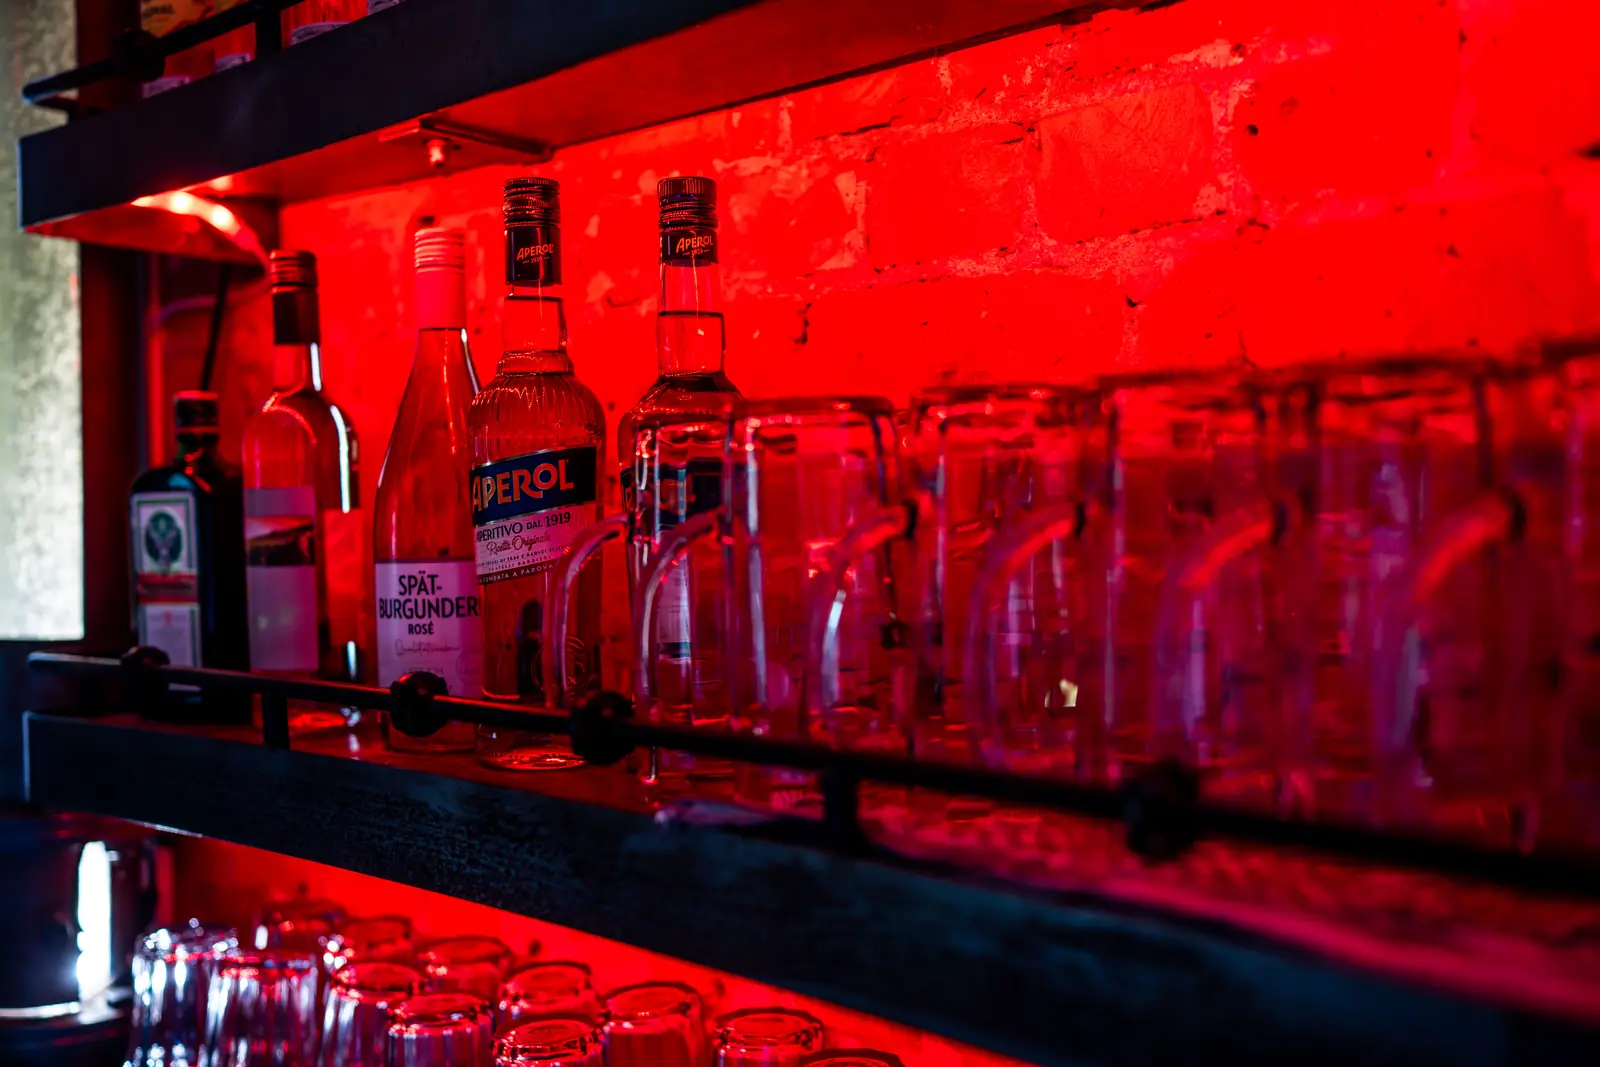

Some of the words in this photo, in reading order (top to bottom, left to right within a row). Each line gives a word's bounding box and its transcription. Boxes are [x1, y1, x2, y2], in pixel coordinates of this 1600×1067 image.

[516, 243, 554, 260] APEROL
[676, 235, 714, 254] APEROL
[473, 459, 574, 512] APEROL
[526, 519, 543, 530] DAL
[545, 511, 571, 527] 1919
[521, 563, 554, 575] PADOVA
[399, 570, 442, 595] SPÄT-
[379, 596, 479, 619] BURGUNDER
[408, 621, 434, 634] ROSÉ
